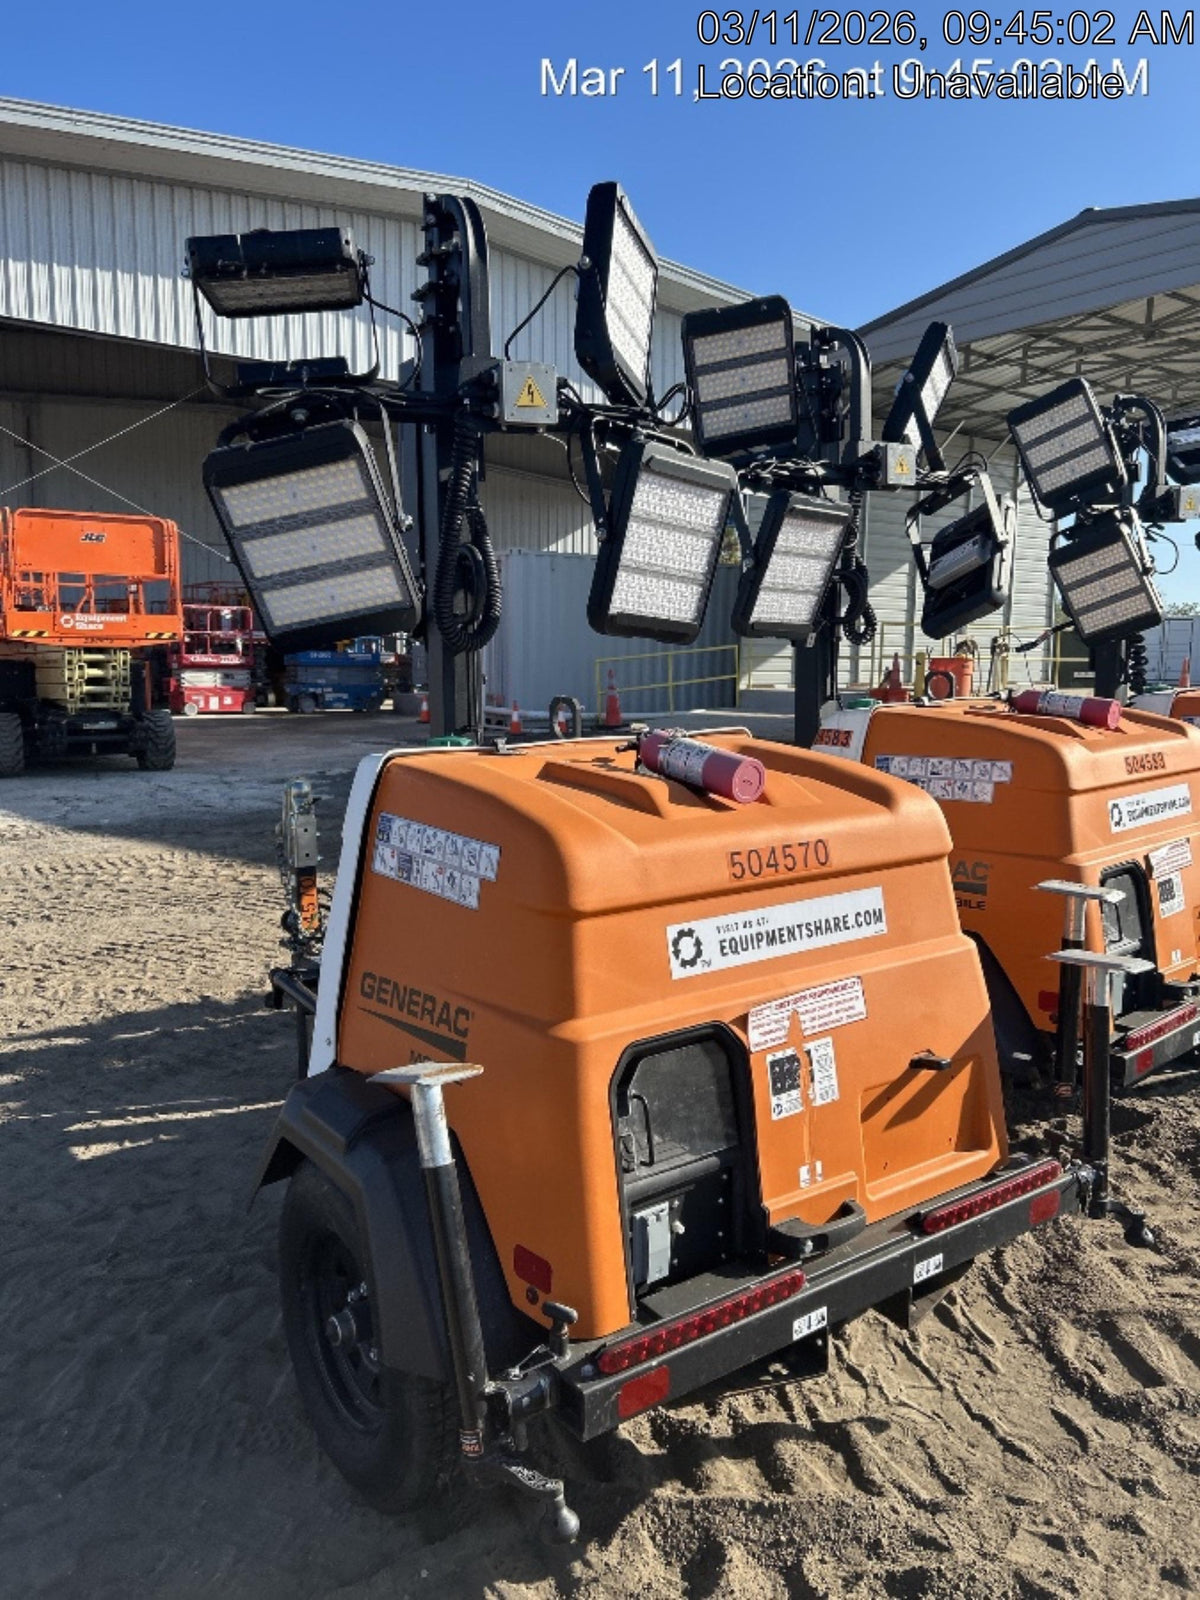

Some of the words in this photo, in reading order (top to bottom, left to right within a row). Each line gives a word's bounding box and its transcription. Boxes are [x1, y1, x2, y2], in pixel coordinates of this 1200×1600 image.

[729, 839, 830, 880] 504570
[718, 907, 884, 958] EQUIPMENTSHARE.COM
[360, 970, 471, 1039] GENERAC
